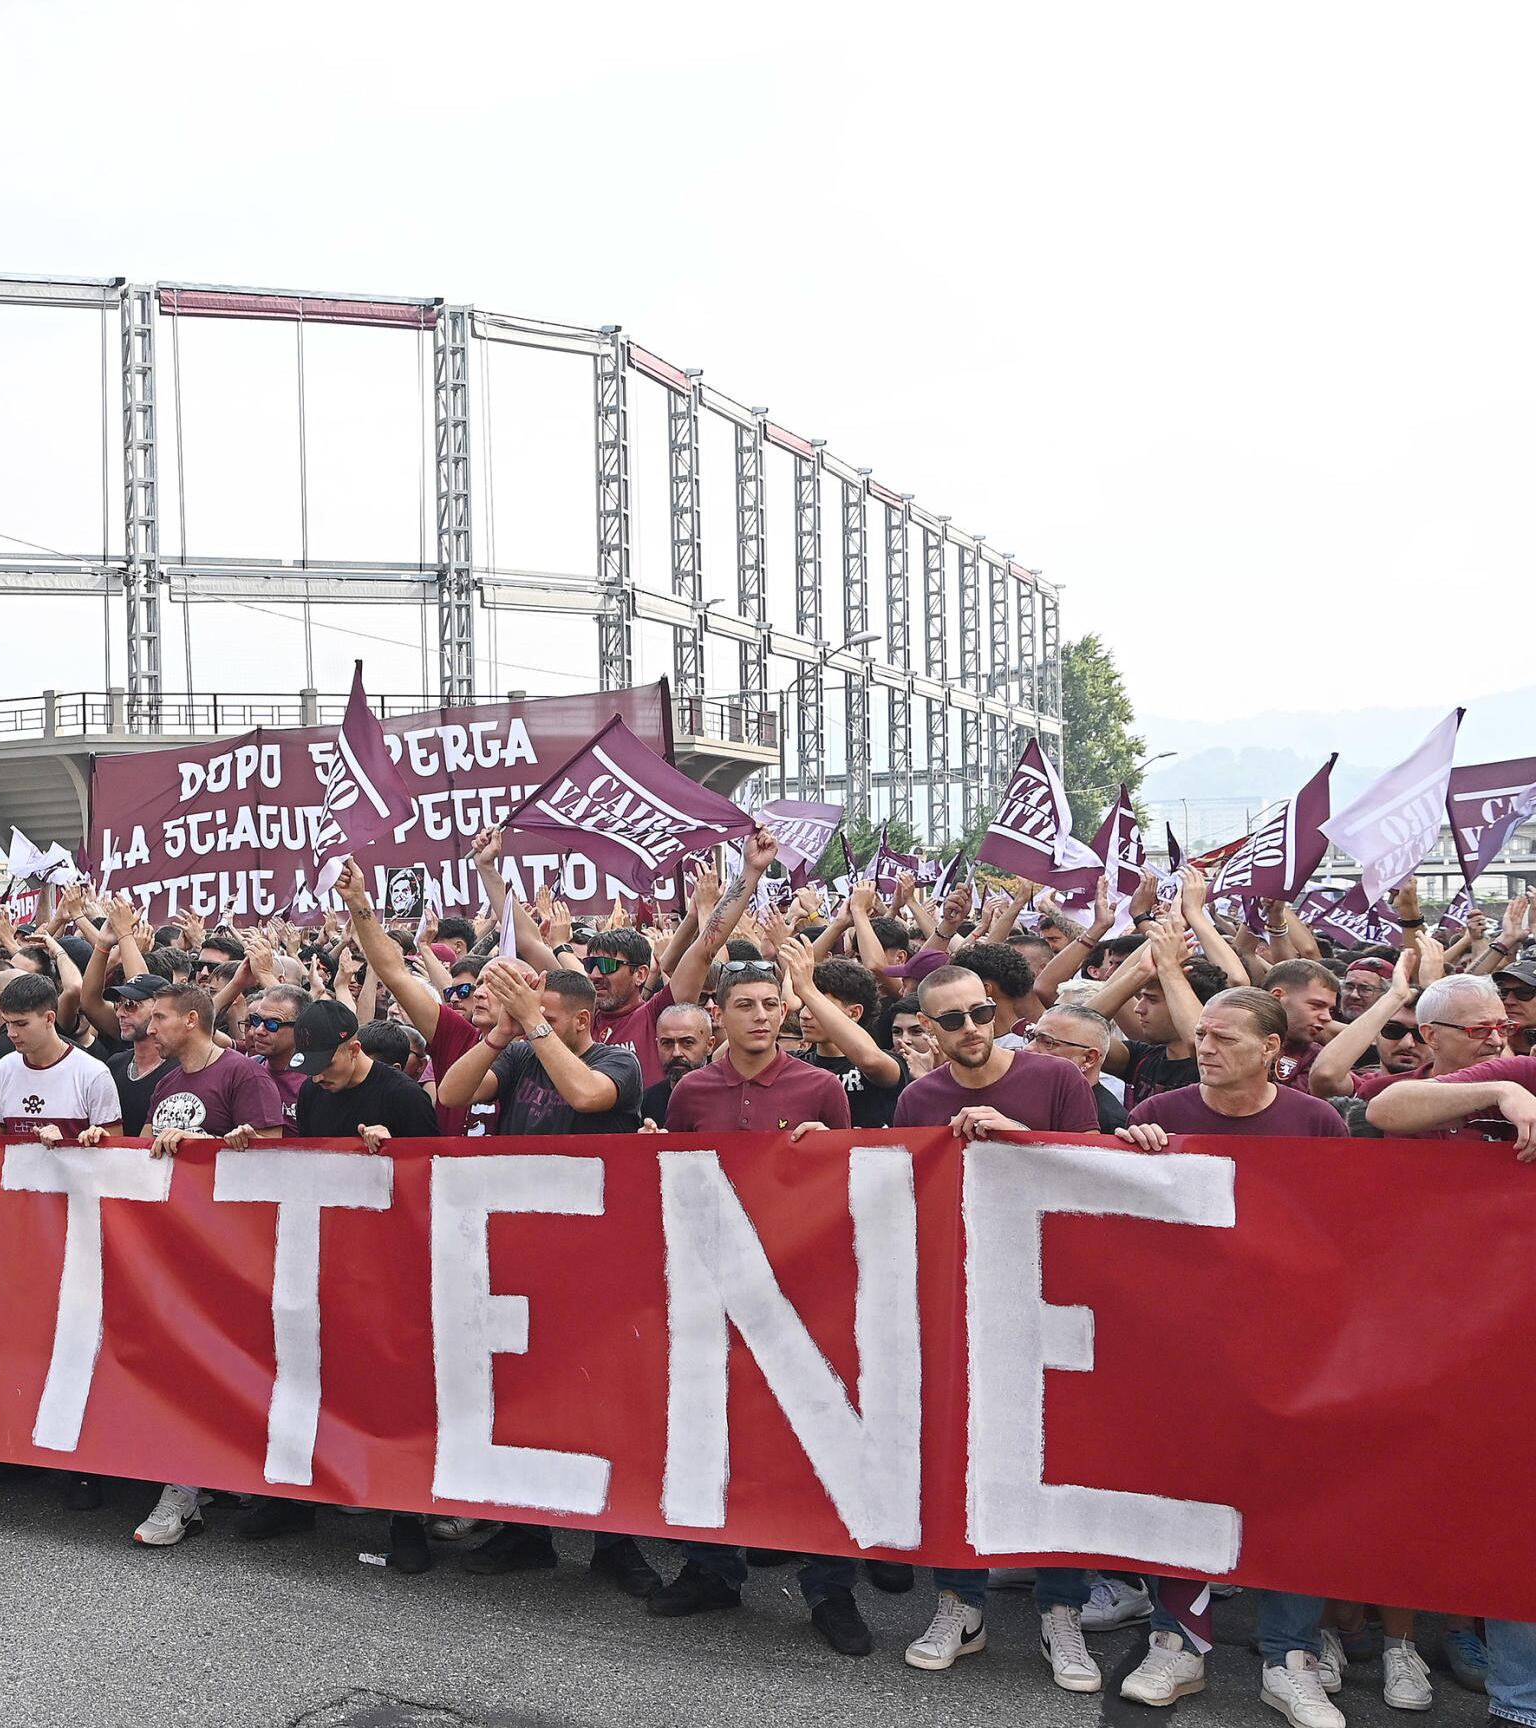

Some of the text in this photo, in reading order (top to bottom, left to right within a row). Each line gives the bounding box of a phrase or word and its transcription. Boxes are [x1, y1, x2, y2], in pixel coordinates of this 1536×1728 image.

[178, 744, 281, 802] DOPO
[549, 777, 686, 863] VATTENE
[587, 774, 697, 833] CAIRO
[100, 824, 151, 871] LA
